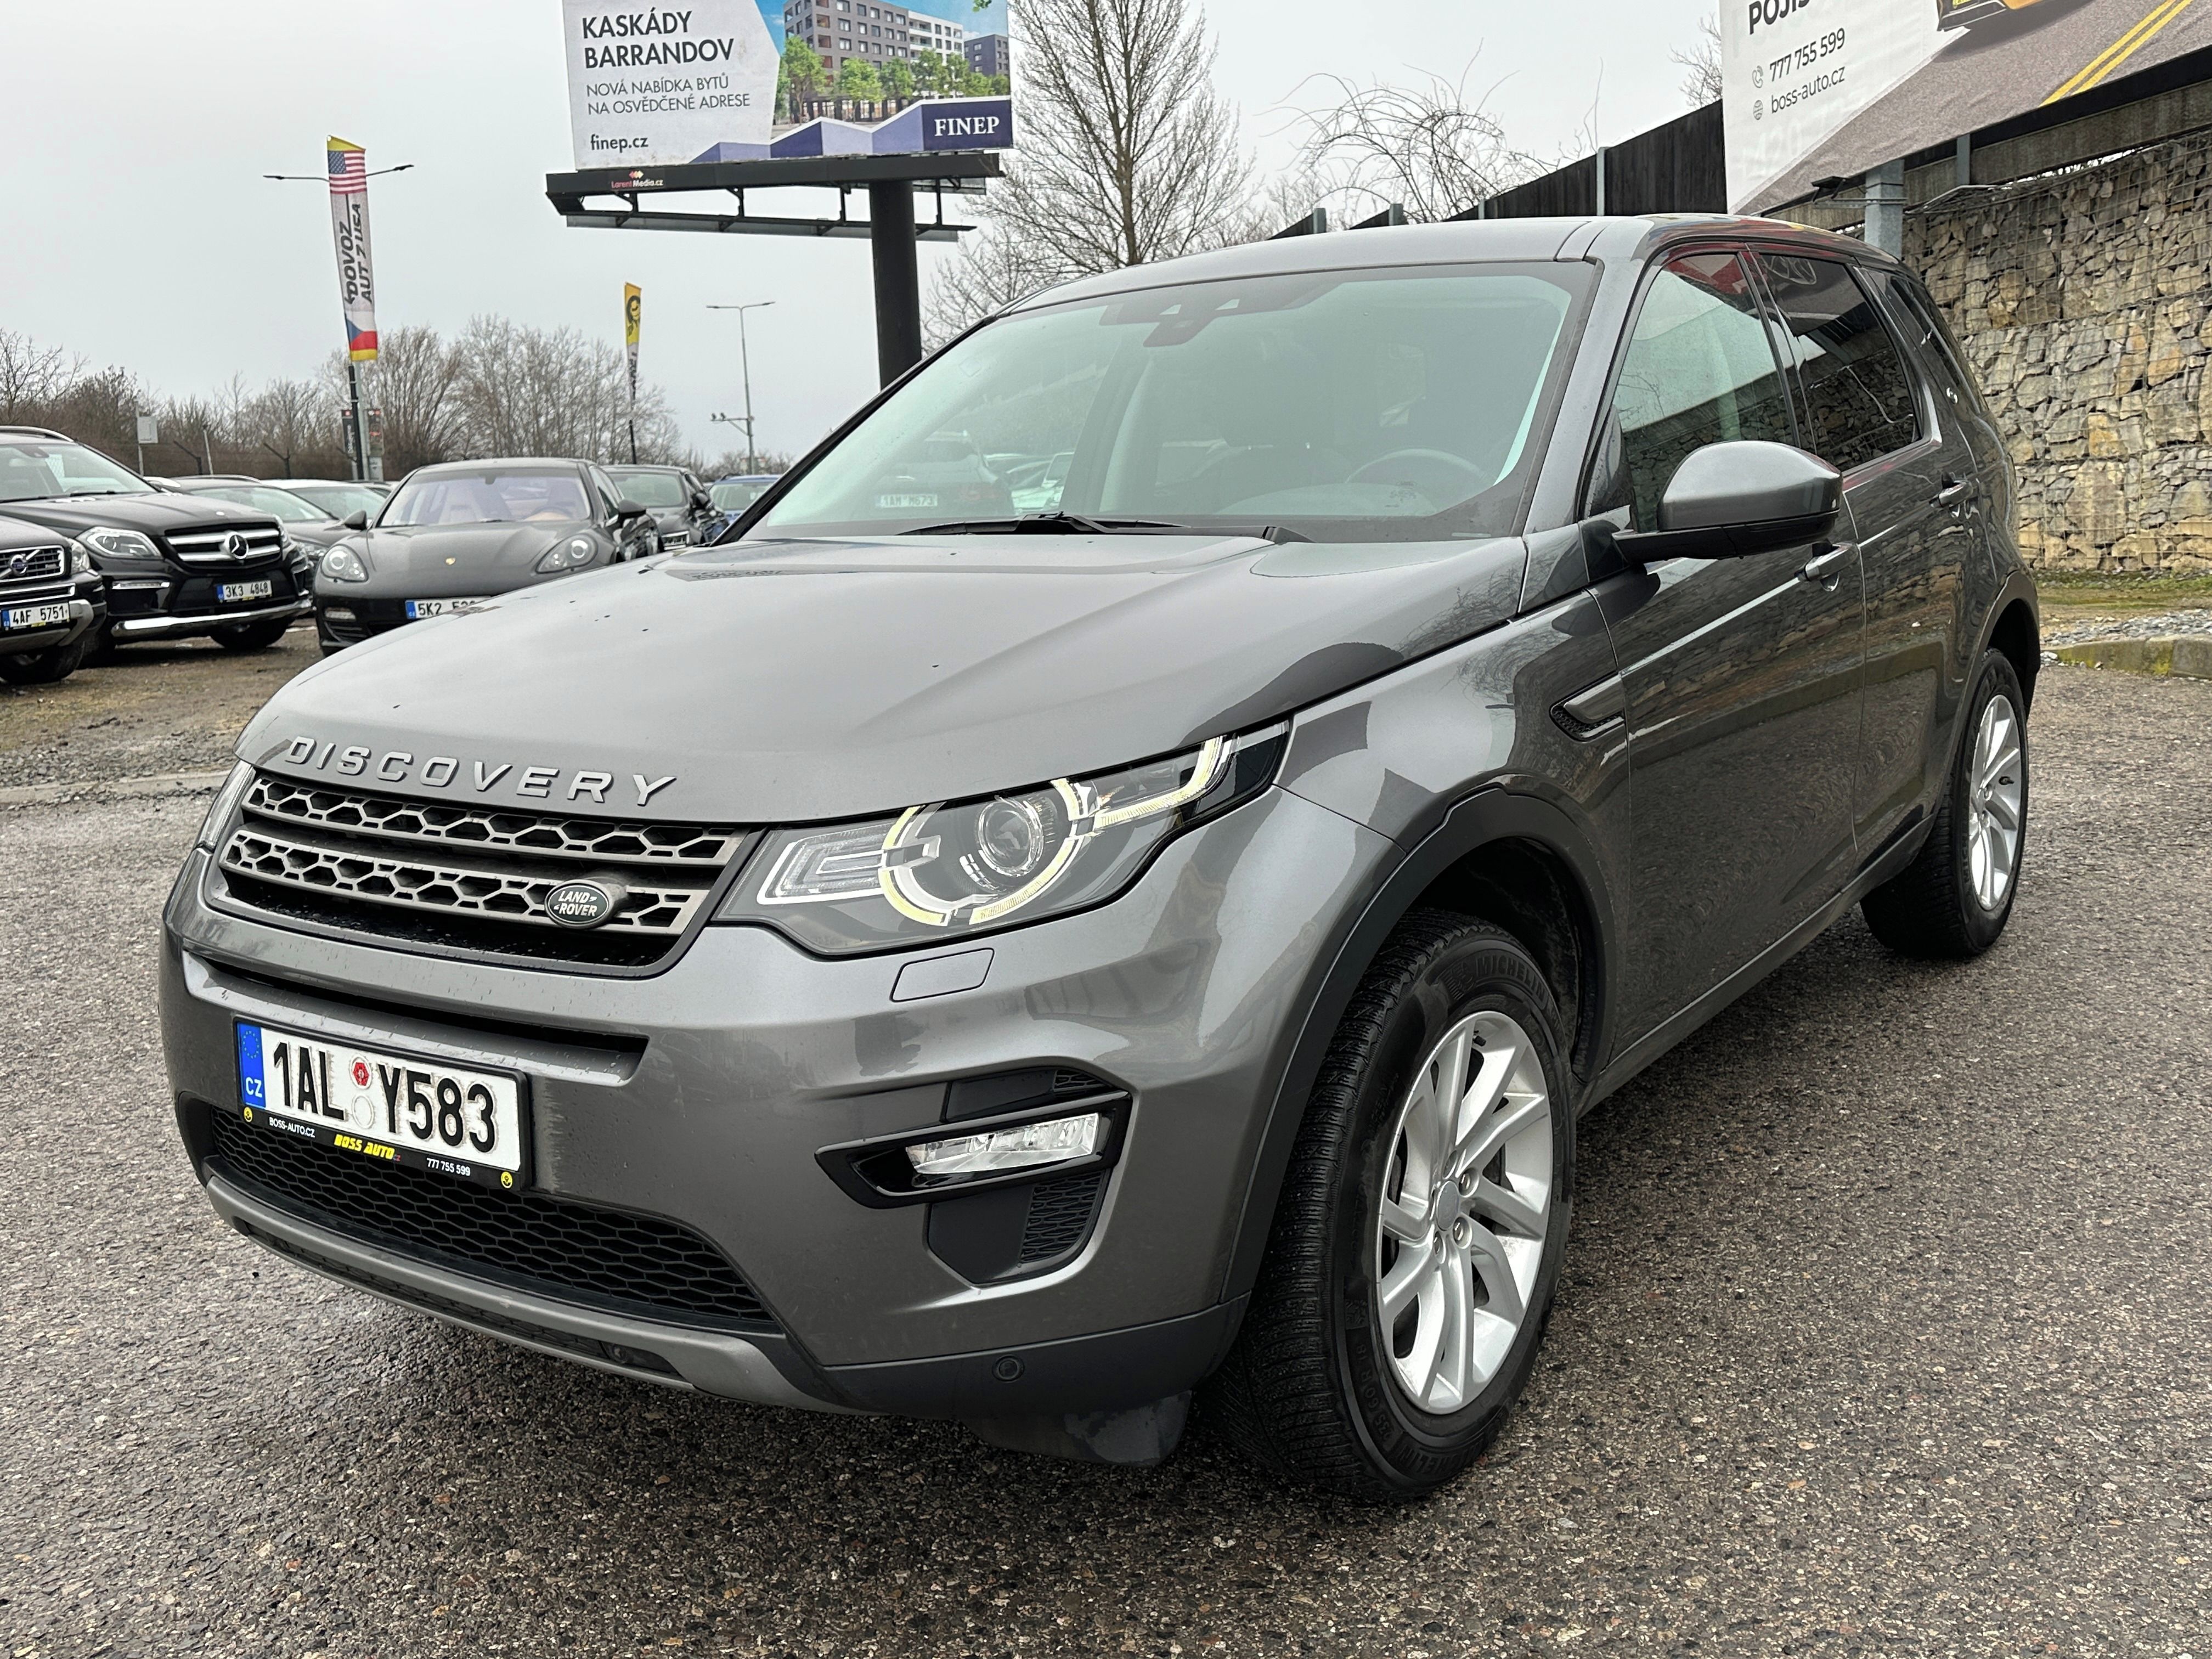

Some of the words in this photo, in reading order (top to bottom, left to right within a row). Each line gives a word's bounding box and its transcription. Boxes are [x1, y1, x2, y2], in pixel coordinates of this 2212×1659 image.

[583, 7, 692, 39] KASKÁDY
[584, 38, 734, 69] BARRANDOV
[1769, 54, 1792, 82] 777
[1795, 41, 1817, 70] 755
[1820, 27, 1846, 57] 599
[586, 79, 628, 97] NOVÁ
[631, 77, 693, 94] NABÍDKA
[697, 72, 729, 91] BYTŮ
[1771, 66, 1846, 114] boss-auto.cz
[588, 101, 610, 115] NA
[613, 93, 695, 114] OSVĚDČENÉ
[699, 93, 751, 109] ADRESE
[934, 116, 1000, 137] FINEP
[590, 133, 649, 154] finep.cz
[339, 221, 358, 303] DOVOZ
[356, 245, 366, 259] Z
[358, 262, 372, 304] AUT
[225, 585, 244, 598] 3K3
[13, 610, 32, 624] 4AF
[40, 605, 64, 621] 5751
[284, 735, 677, 806] DISCOVERY
[558, 890, 590, 904] LAND
[558, 902, 597, 917] ROVER
[1476, 955, 1547, 1003] MICHELIN
[245, 1076, 263, 1098] CZ
[273, 1041, 345, 1121] 1AL
[377, 1063, 495, 1153] Y583
[269, 1116, 316, 1138] BOSS-AUTO.CZ
[334, 1133, 363, 1152] BOSS
[363, 1142, 396, 1160] AUTO
[426, 1157, 439, 1169] 777
[440, 1160, 455, 1173] 755
[456, 1164, 471, 1177] 599
